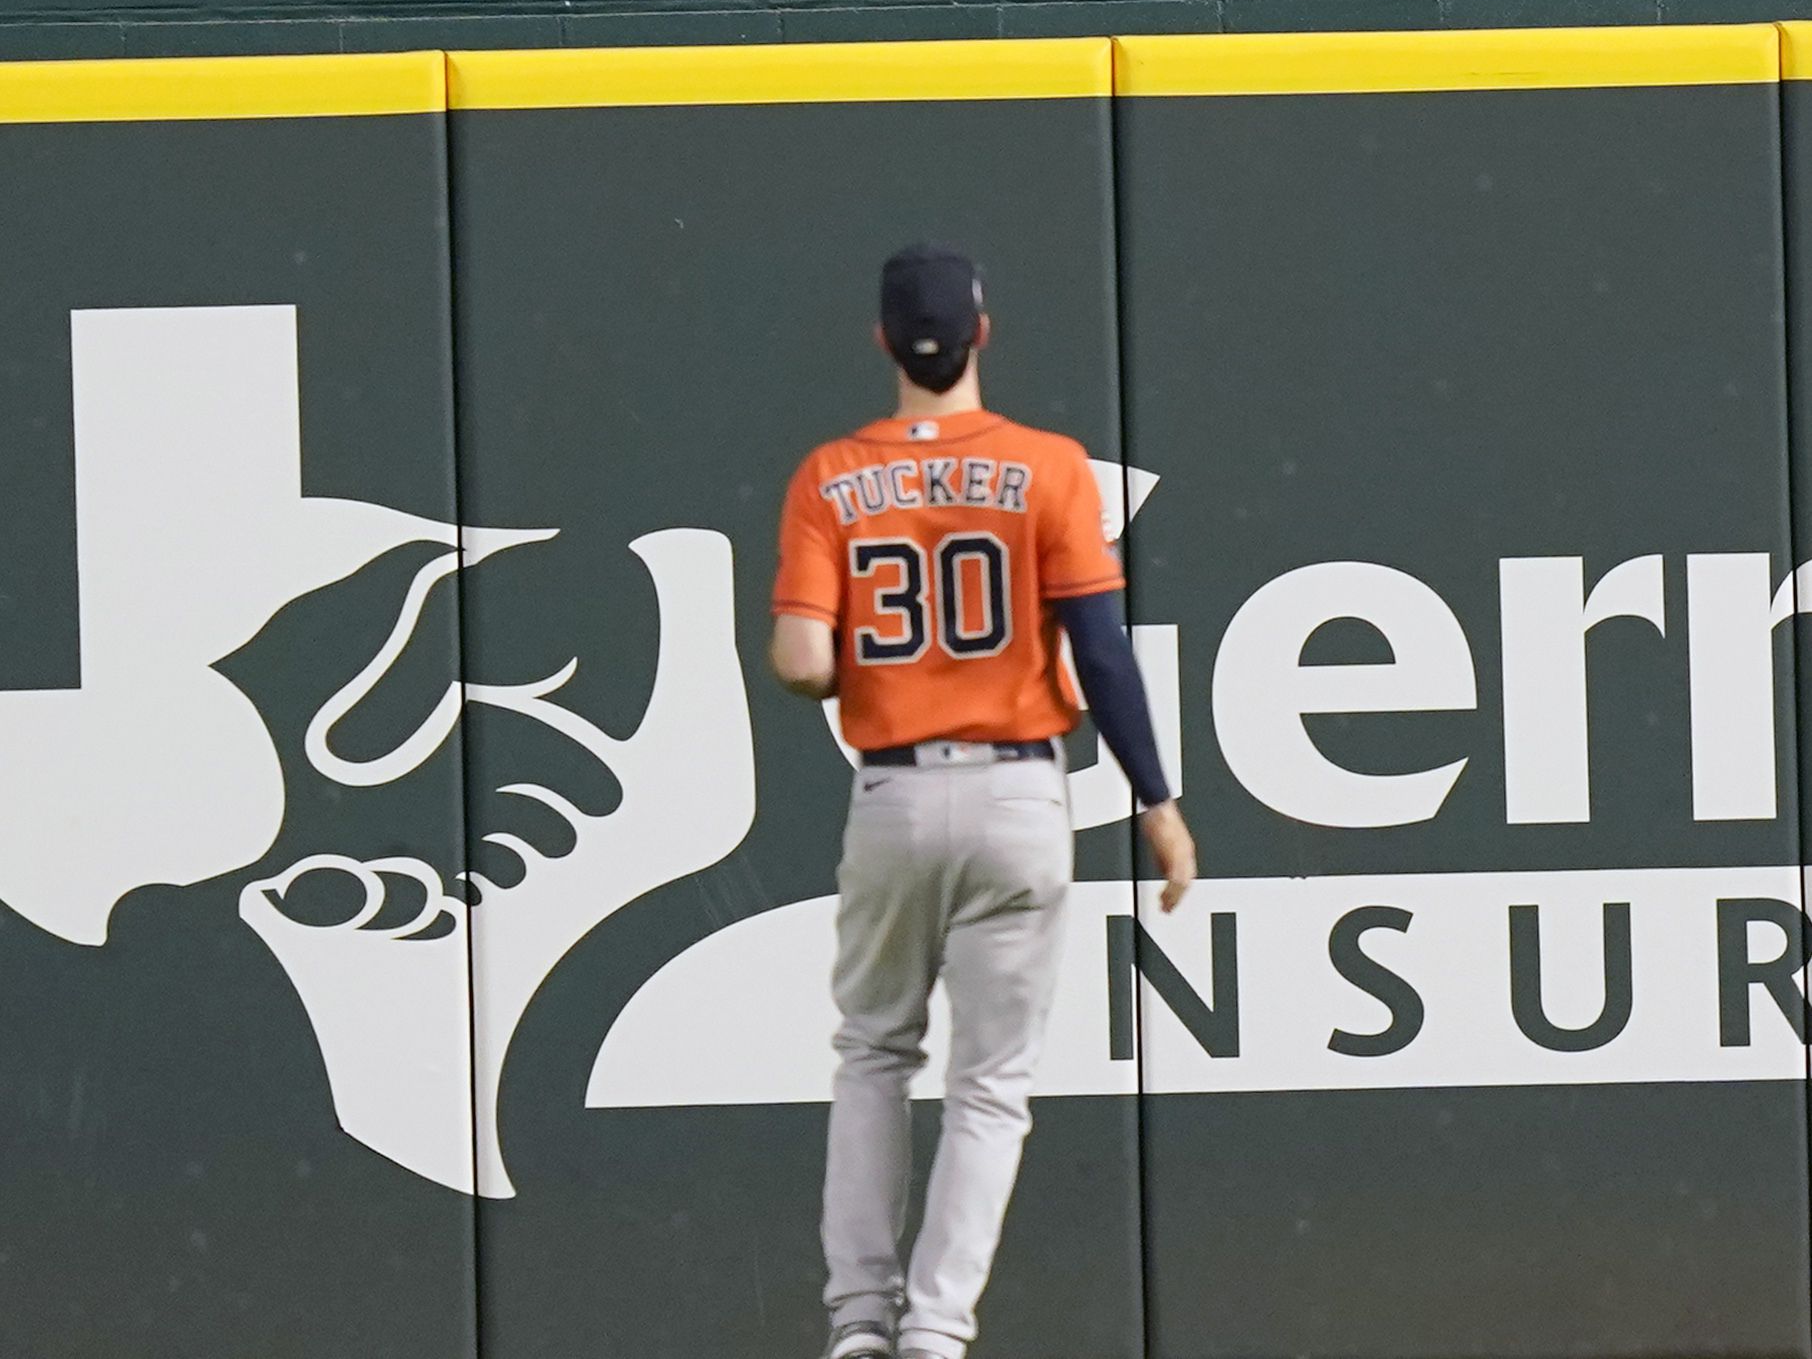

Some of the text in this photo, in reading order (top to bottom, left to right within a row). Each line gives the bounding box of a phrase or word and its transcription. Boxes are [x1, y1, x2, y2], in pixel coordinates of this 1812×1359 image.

[820, 457, 1033, 526] TUCKER
[848, 531, 1013, 667] 30
[1105, 897, 1812, 1062] NSUR
